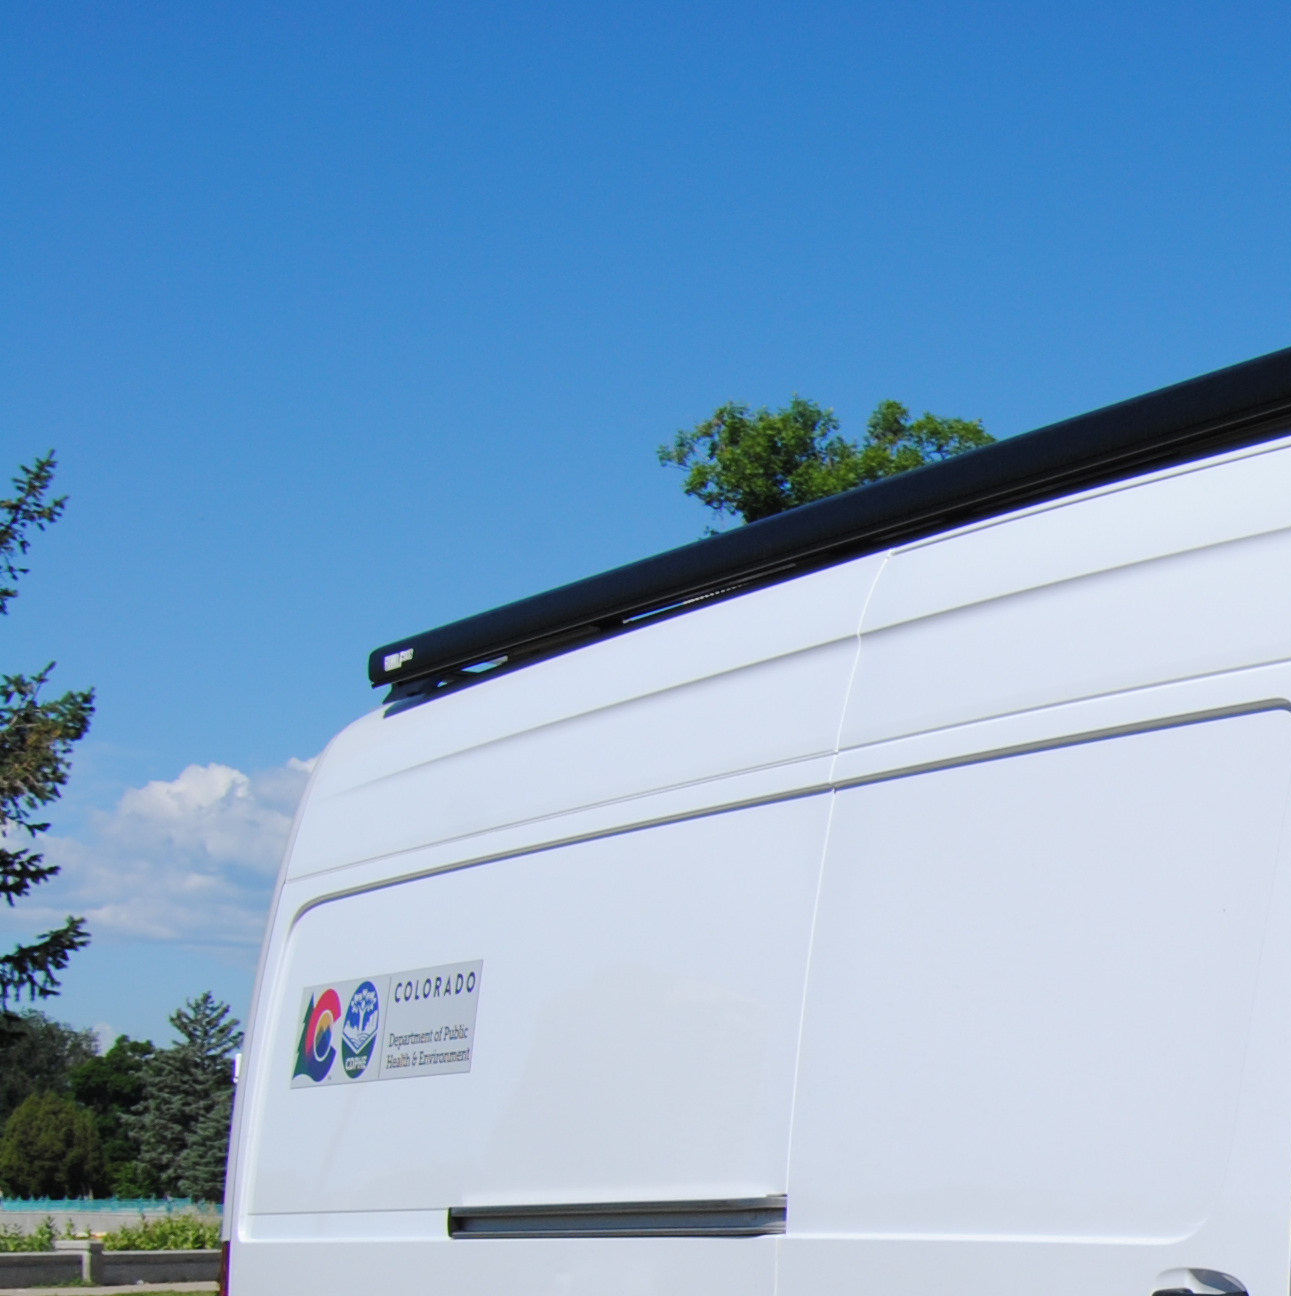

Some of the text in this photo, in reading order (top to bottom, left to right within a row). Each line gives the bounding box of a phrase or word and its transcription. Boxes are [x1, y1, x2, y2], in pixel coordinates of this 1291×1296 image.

[394, 971, 476, 1003] COLORADO
[388, 1024, 469, 1050] Department of Public
[386, 1048, 470, 1069] Health & Environment
